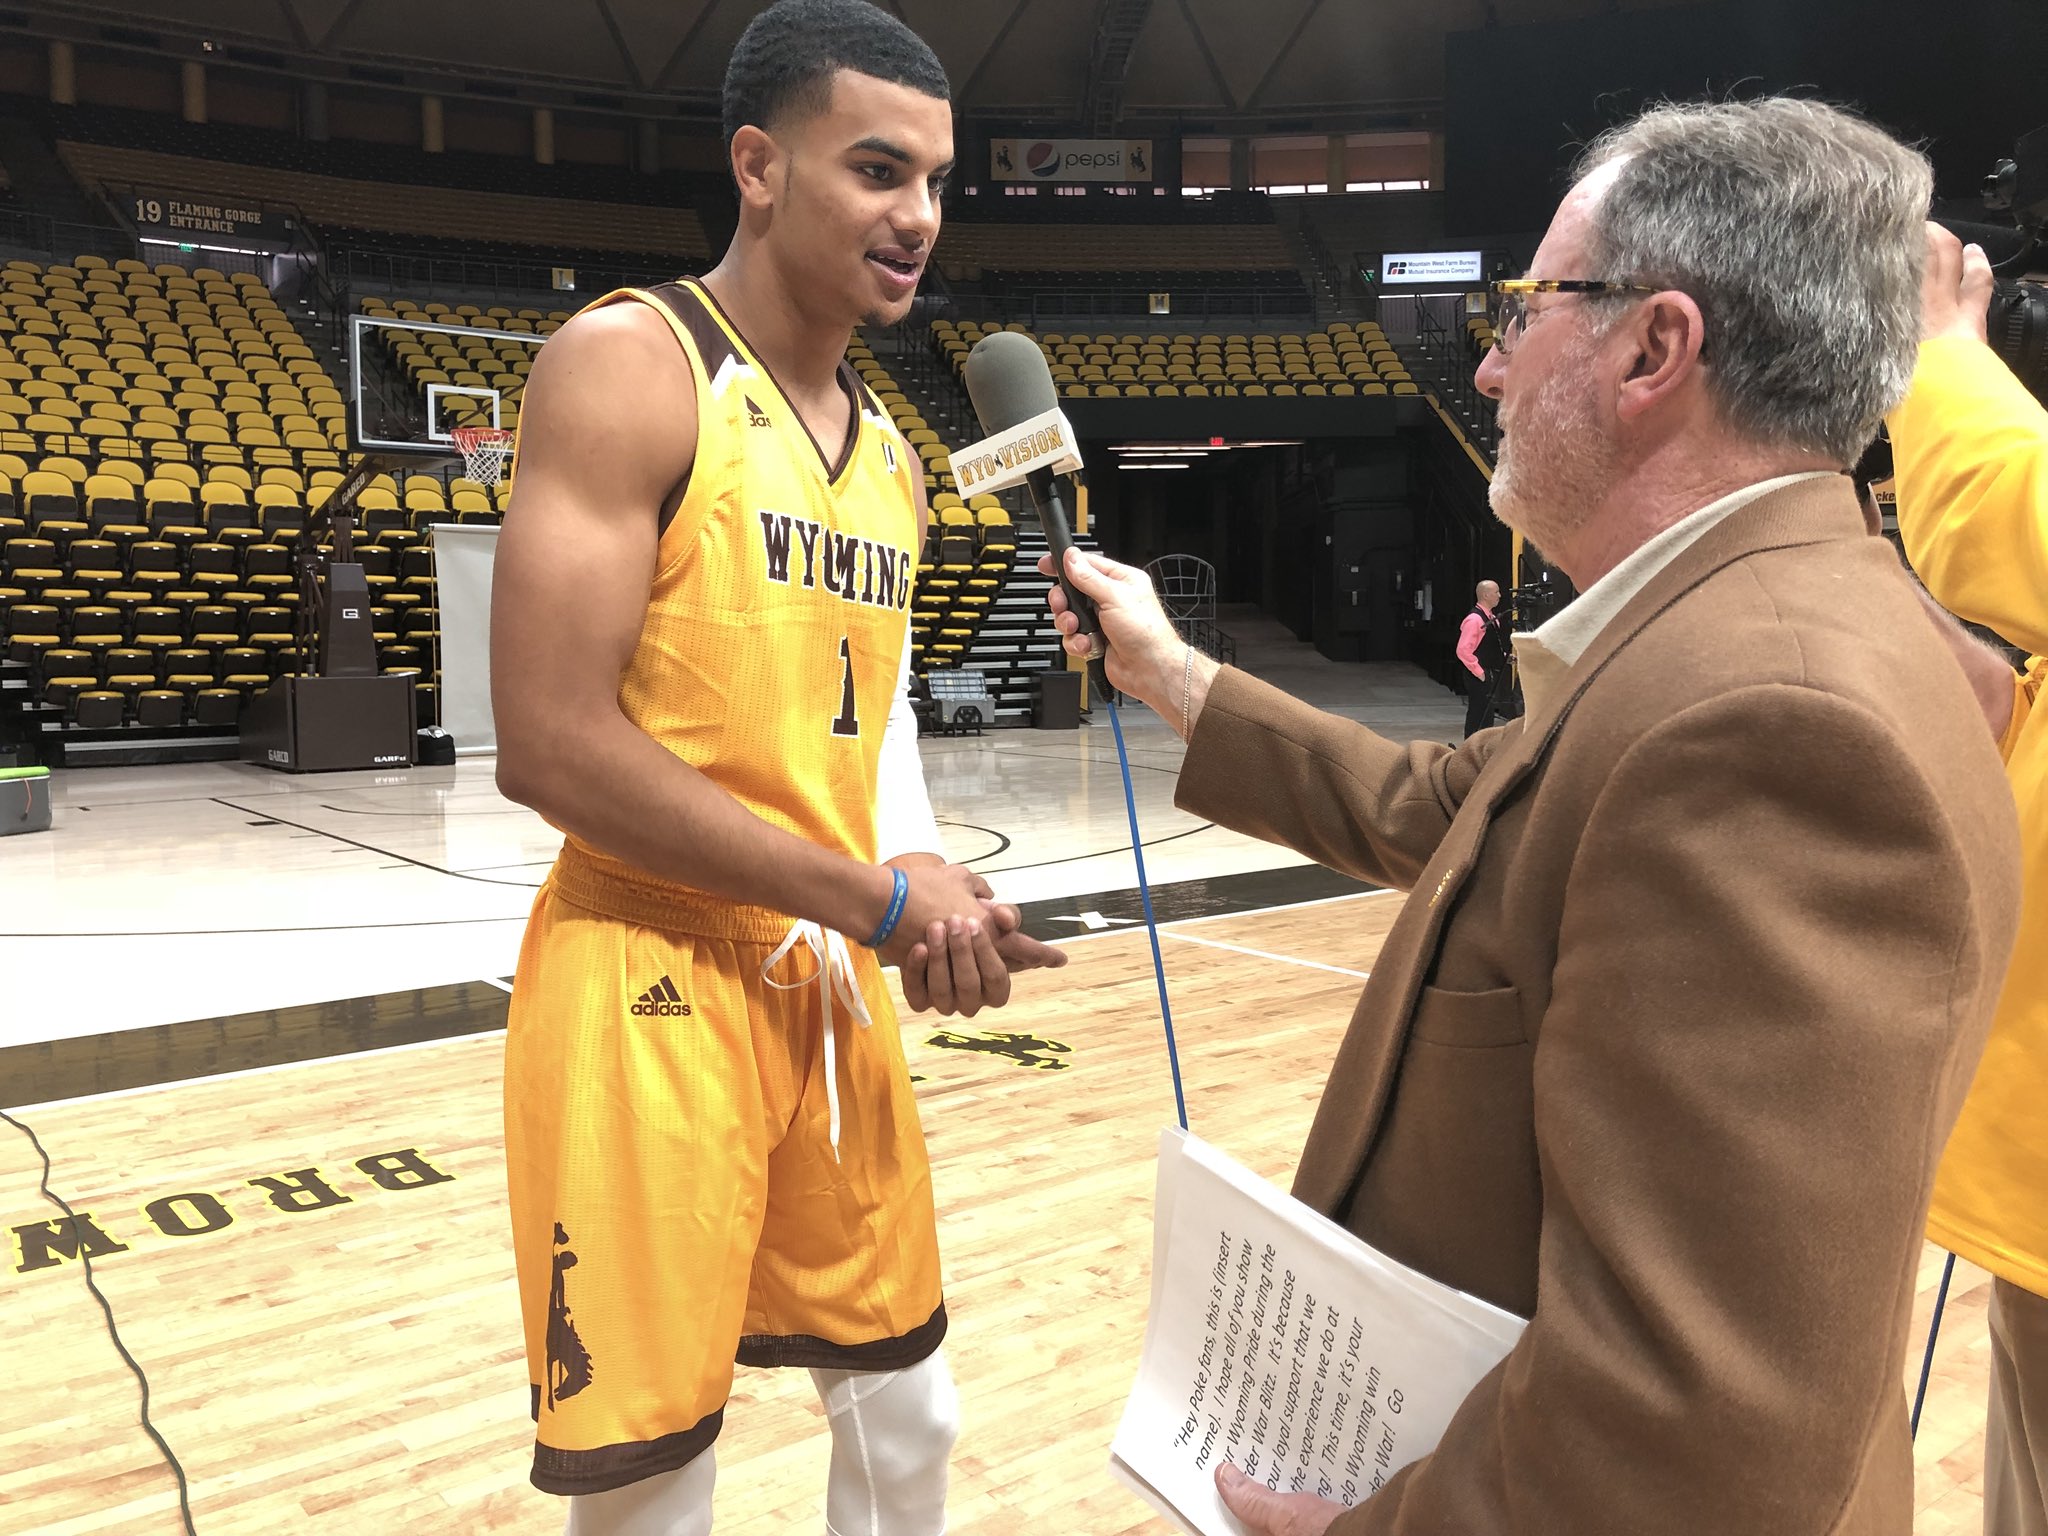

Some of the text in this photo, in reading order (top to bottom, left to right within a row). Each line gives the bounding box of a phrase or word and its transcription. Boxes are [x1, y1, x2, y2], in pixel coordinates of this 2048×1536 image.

[1065, 151, 1120, 169] pepsi
[136, 199, 262, 224] 19 FLAMING GORGE
[169, 214, 234, 233] ENTRANCE
[957, 424, 1063, 487] WYO VISION
[342, 472, 366, 505] GARED
[760, 511, 910, 611] WYOMING
[831, 636, 859, 736] 1
[631, 1000, 691, 1016] adidas
[11, 1148, 457, 1274] BROW
[1213, 1231, 1231, 1287] (insert
[1260, 1244, 1276, 1273] the
[1205, 1300, 1220, 1331] this
[1210, 1285, 1222, 1301] is
[1251, 1274, 1273, 1328] during
[1195, 1239, 1253, 1470] name). I hope all of you show
[1198, 1336, 1217, 1376] fans,
[1243, 1329, 1261, 1371] Pride
[1252, 1409, 1268, 1445] War
[1260, 1373, 1277, 1410] Blitz.
[1272, 1269, 1297, 1338] because
[1347, 1317, 1363, 1362] your
[1190, 1372, 1207, 1412] Poke
[1272, 1417, 1290, 1462] loyal
[1284, 1357, 1303, 1422] support
[1294, 1320, 1310, 1358] that
[1303, 1293, 1316, 1320] we
[1290, 1305, 1340, 1493] the experience we do at
[1227, 1371, 1255, 1446] Wyoming
[1330, 1392, 1351, 1431] time,
[1374, 1421, 1396, 1469] War!
[1387, 1388, 1404, 1415] Go
[1322, 1432, 1339, 1465] This
[1341, 1366, 1381, 1507] elp Wyoming win
